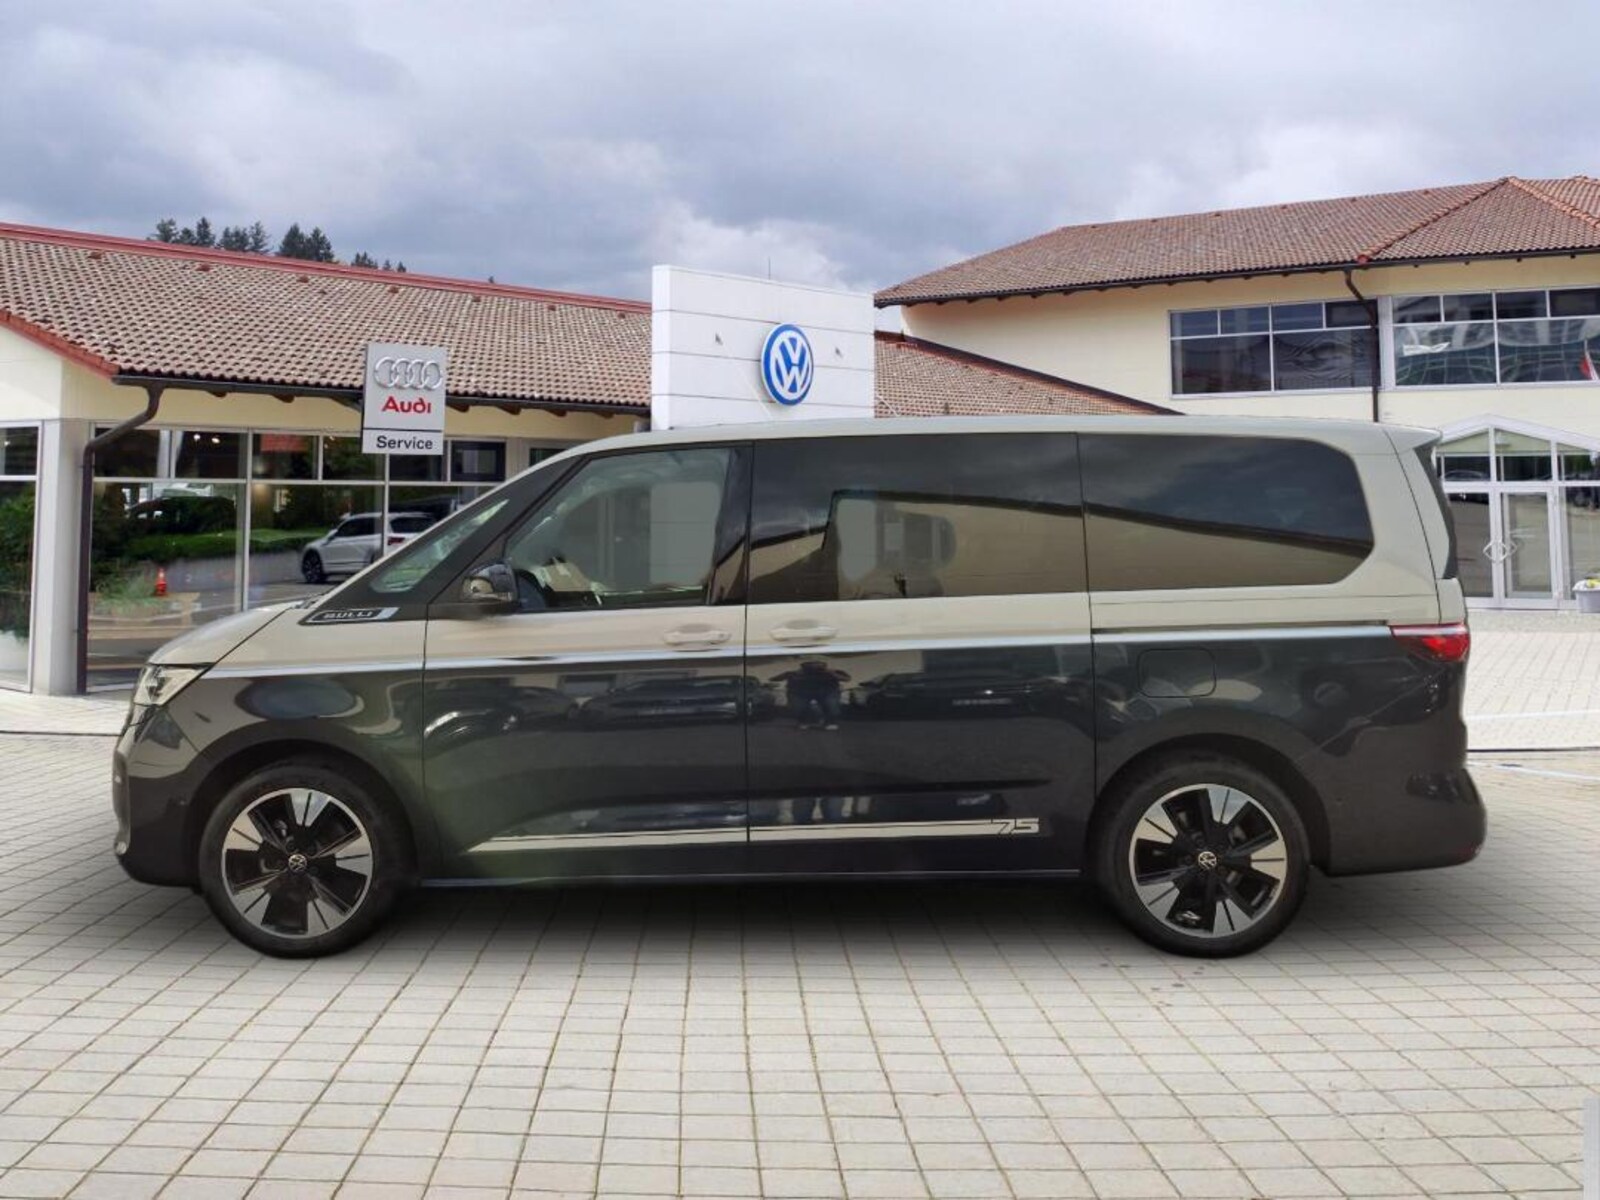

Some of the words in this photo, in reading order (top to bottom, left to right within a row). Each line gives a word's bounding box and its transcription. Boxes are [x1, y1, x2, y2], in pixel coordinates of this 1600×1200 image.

[764, 326, 813, 404] VW
[381, 396, 431, 414] Audi
[376, 435, 433, 450] Service
[991, 817, 1039, 835] 75
